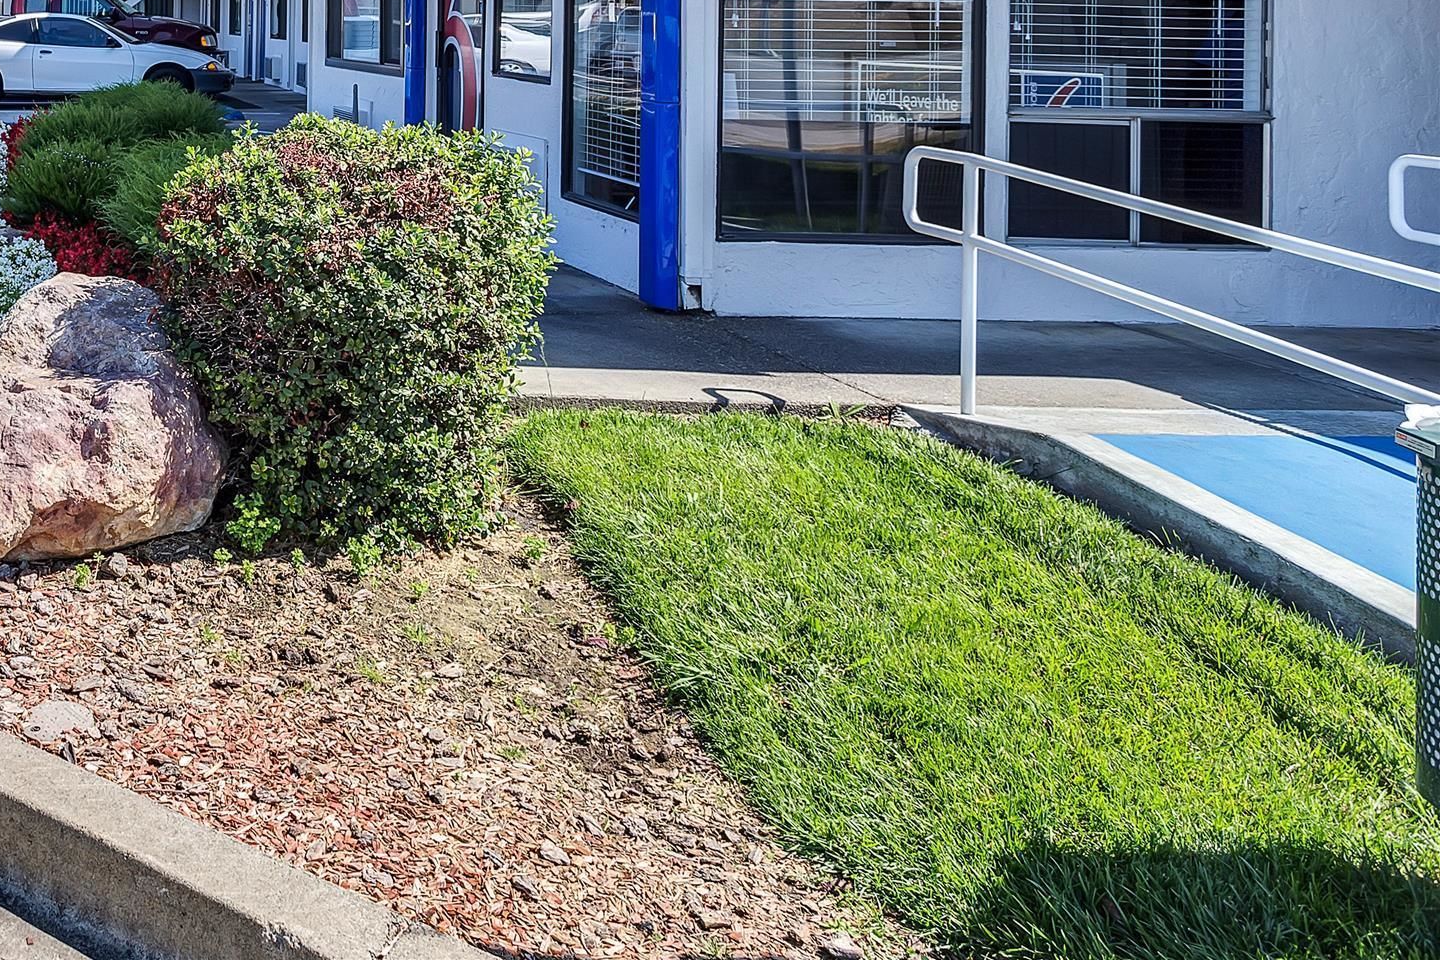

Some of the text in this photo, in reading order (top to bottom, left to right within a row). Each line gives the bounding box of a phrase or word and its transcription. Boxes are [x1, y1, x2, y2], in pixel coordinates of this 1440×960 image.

[865, 87, 960, 112] We'll leave the
